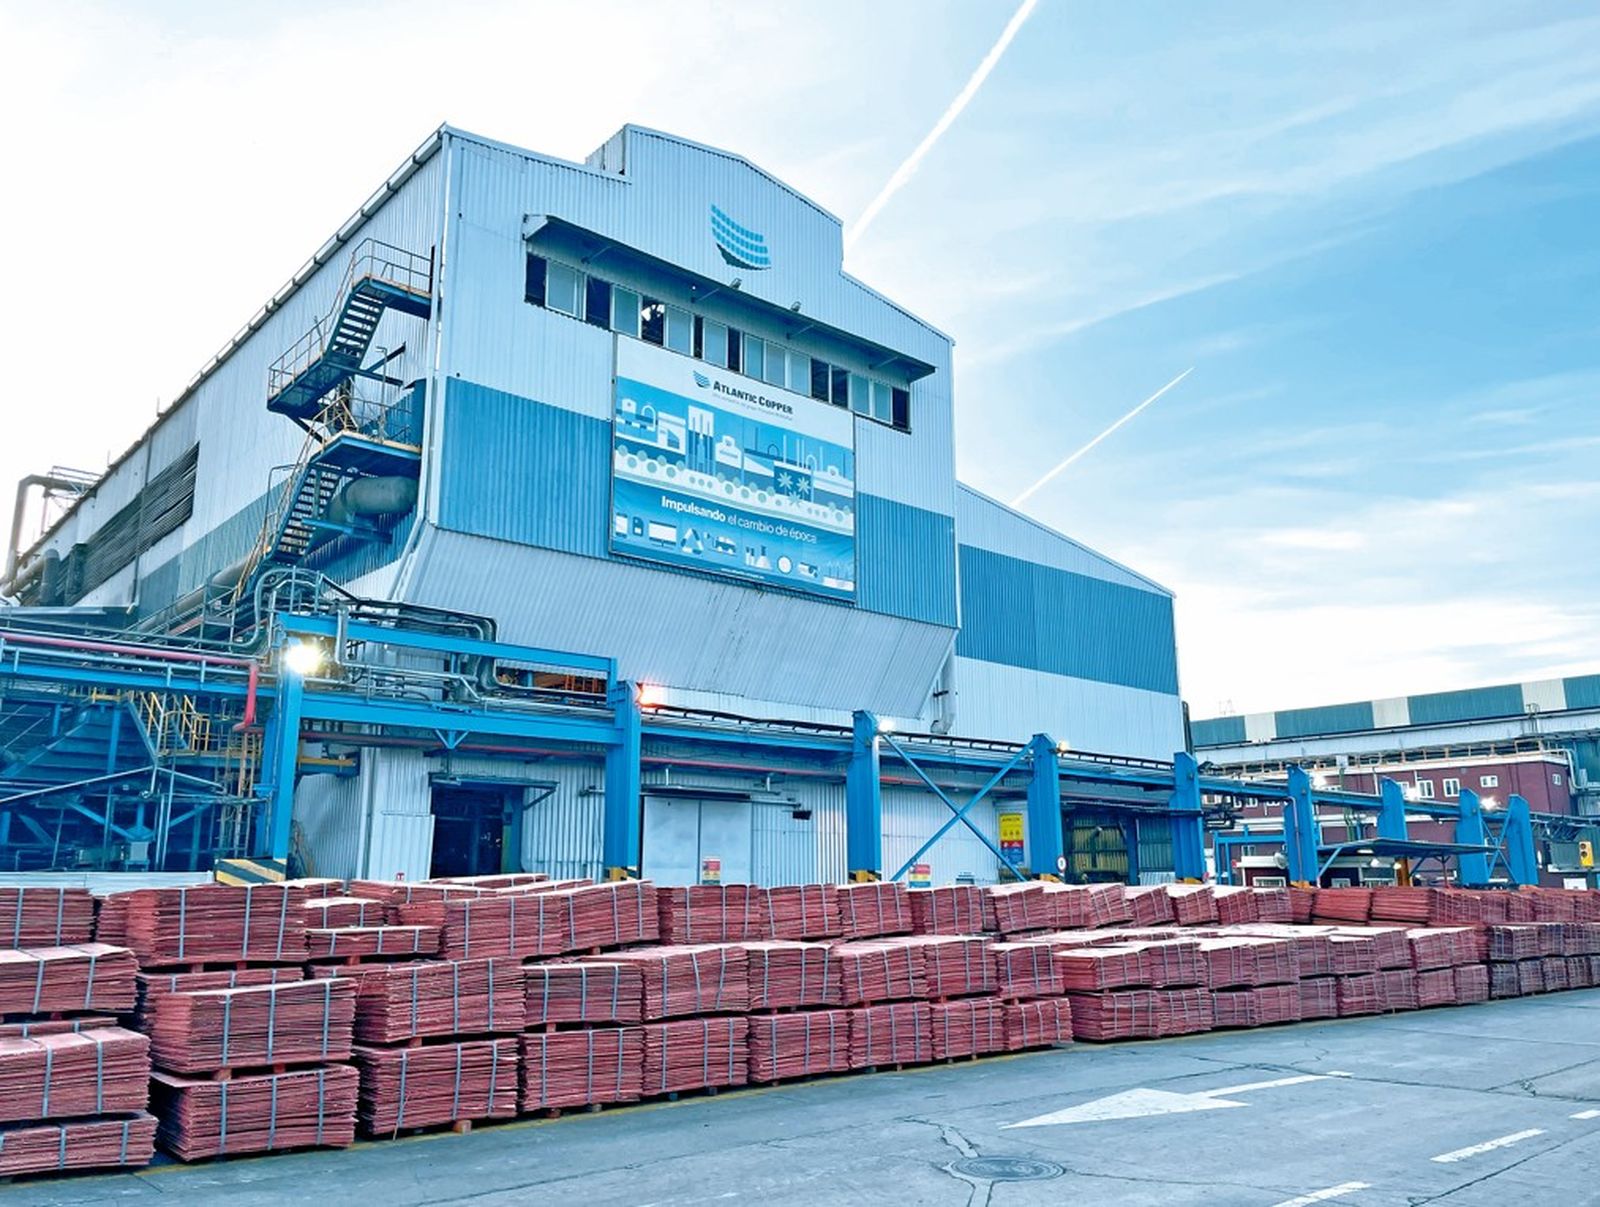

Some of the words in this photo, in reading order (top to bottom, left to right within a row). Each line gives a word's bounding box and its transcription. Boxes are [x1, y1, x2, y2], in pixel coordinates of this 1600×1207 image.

[713, 381, 757, 404] ATLANTIC
[759, 396, 793, 415] COPPER
[661, 496, 726, 522] Impulsando
[728, 516, 736, 525] el
[738, 517, 774, 534] cambio
[775, 524, 788, 537] de
[789, 527, 817, 544] época
